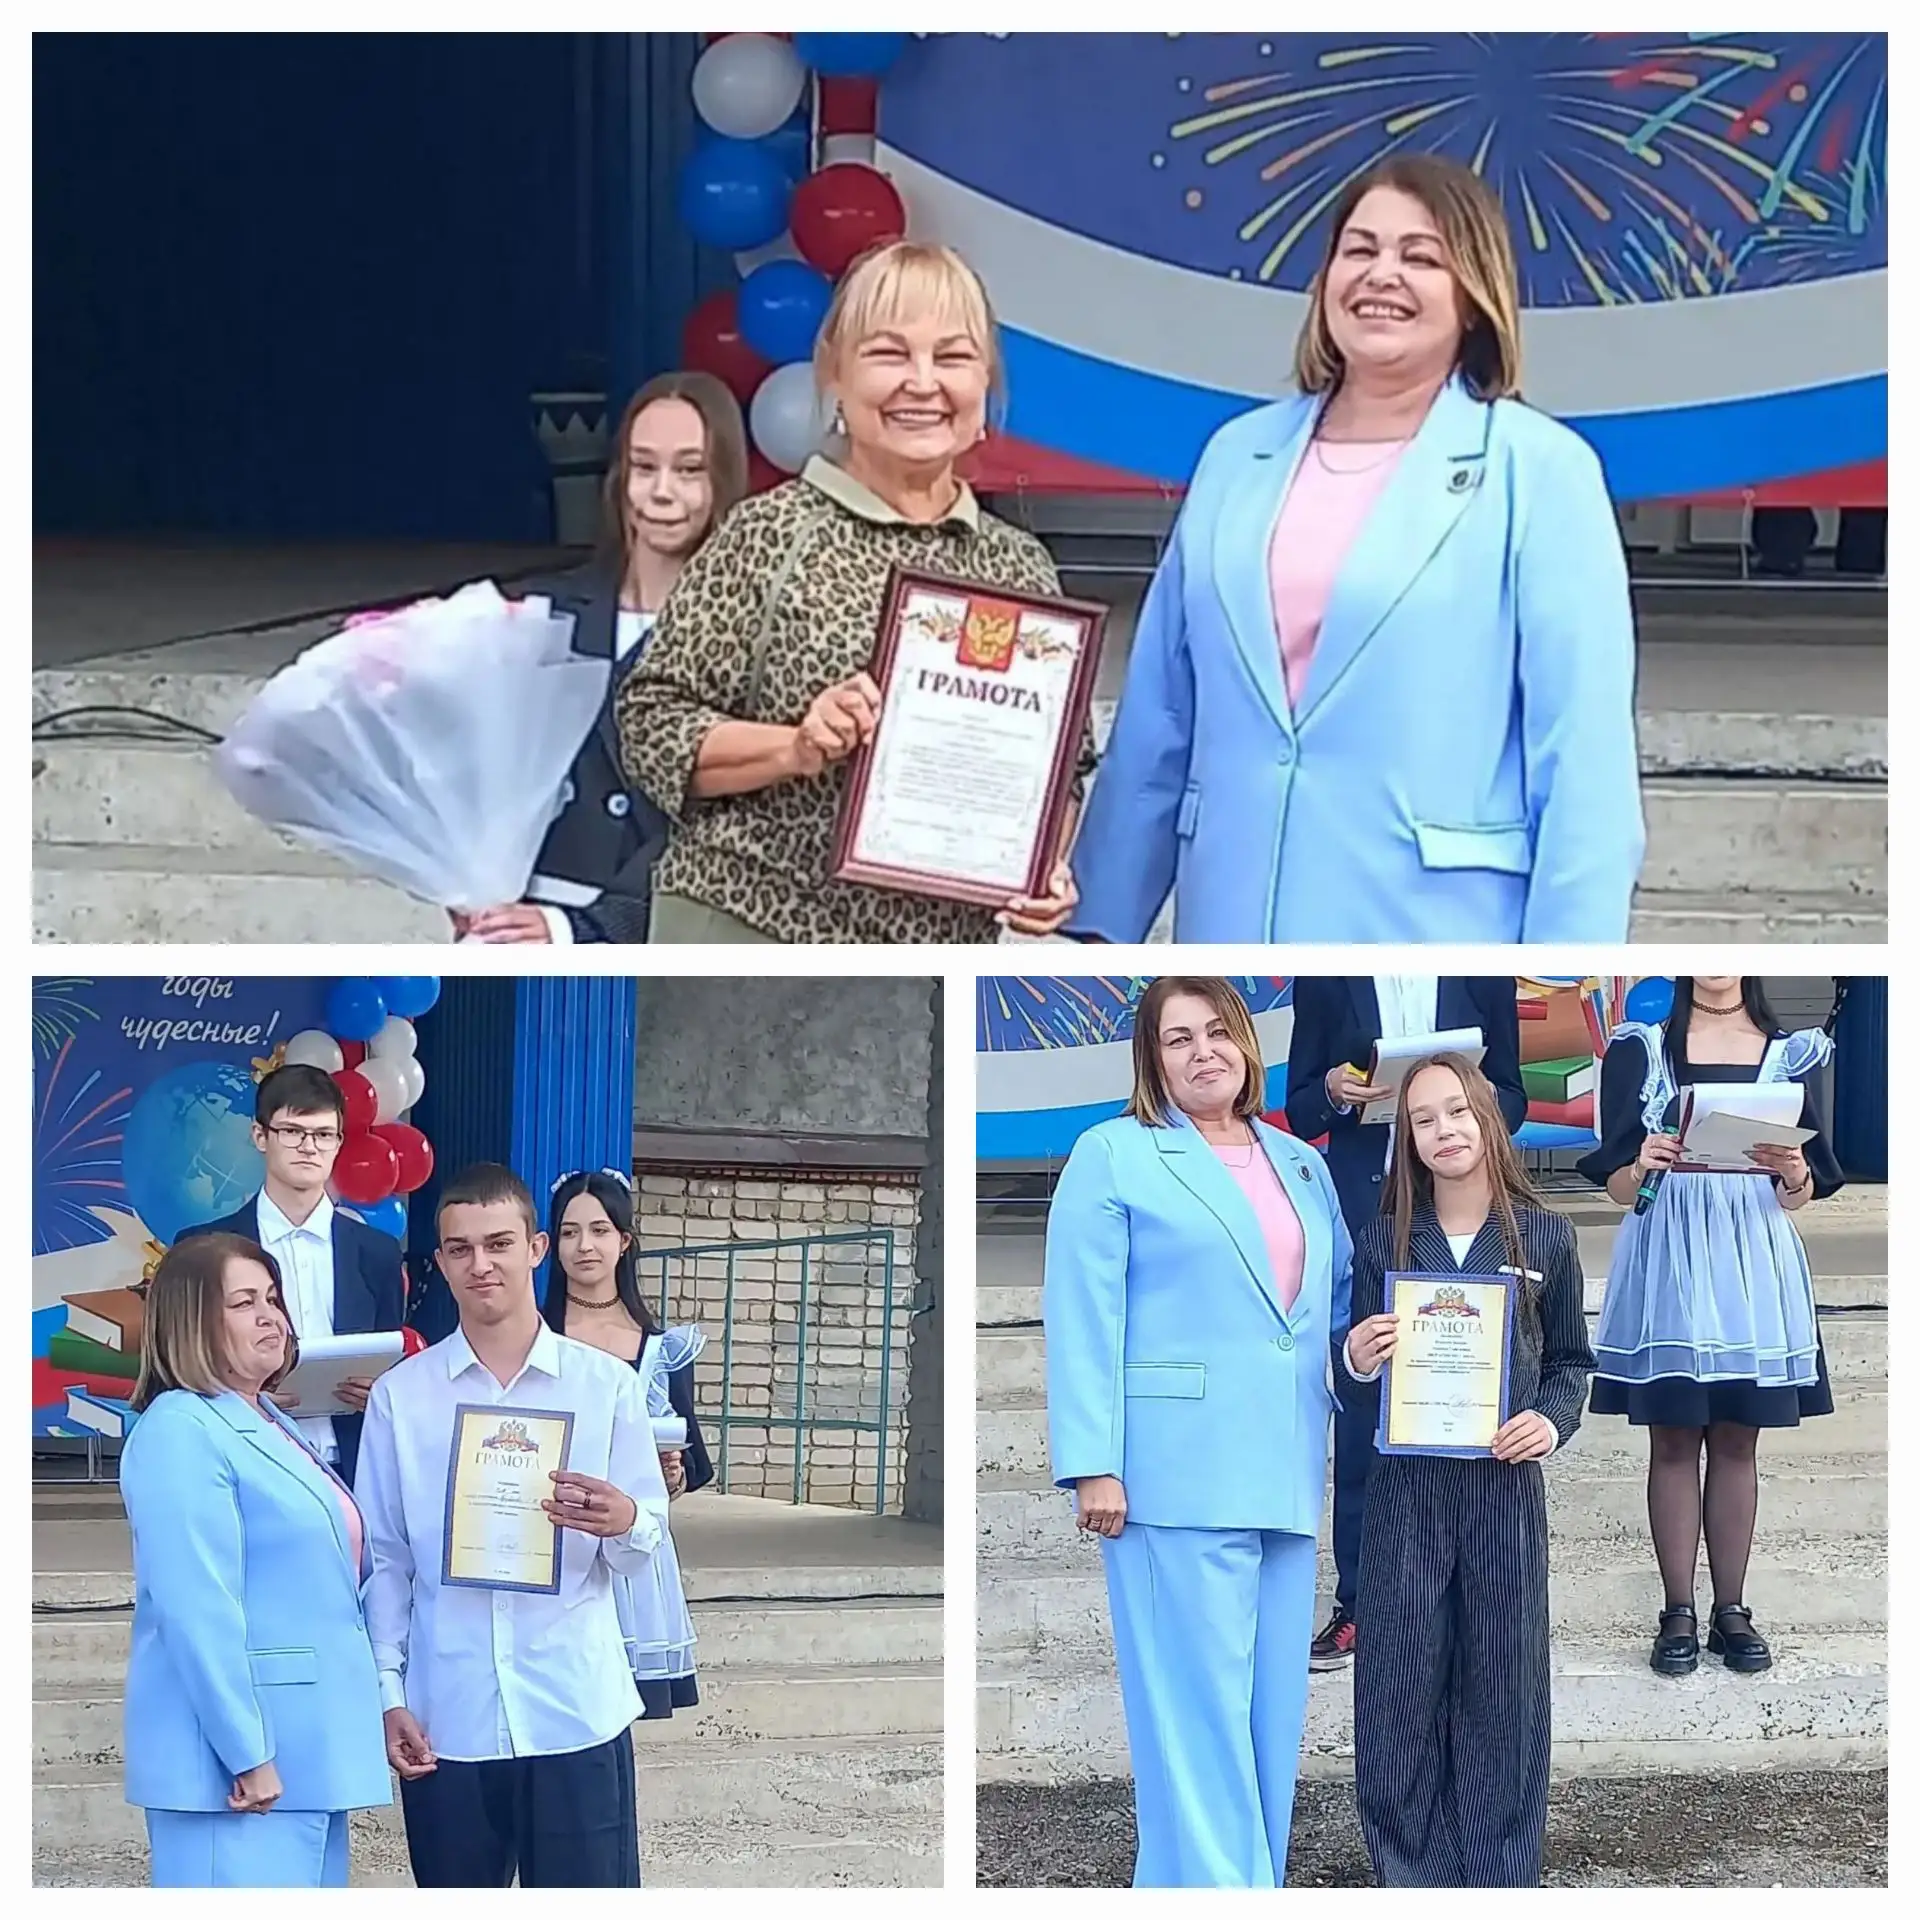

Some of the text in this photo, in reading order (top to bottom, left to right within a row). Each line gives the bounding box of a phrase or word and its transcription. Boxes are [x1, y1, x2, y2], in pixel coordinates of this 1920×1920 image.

[917, 670, 1042, 713] ГРАМОТА
[162, 976, 234, 1008] годы
[121, 1010, 280, 1050] чудесные!
[1412, 1320, 1483, 1334] ГРАМОТА
[475, 1452, 540, 1469] ГРАМОТА
